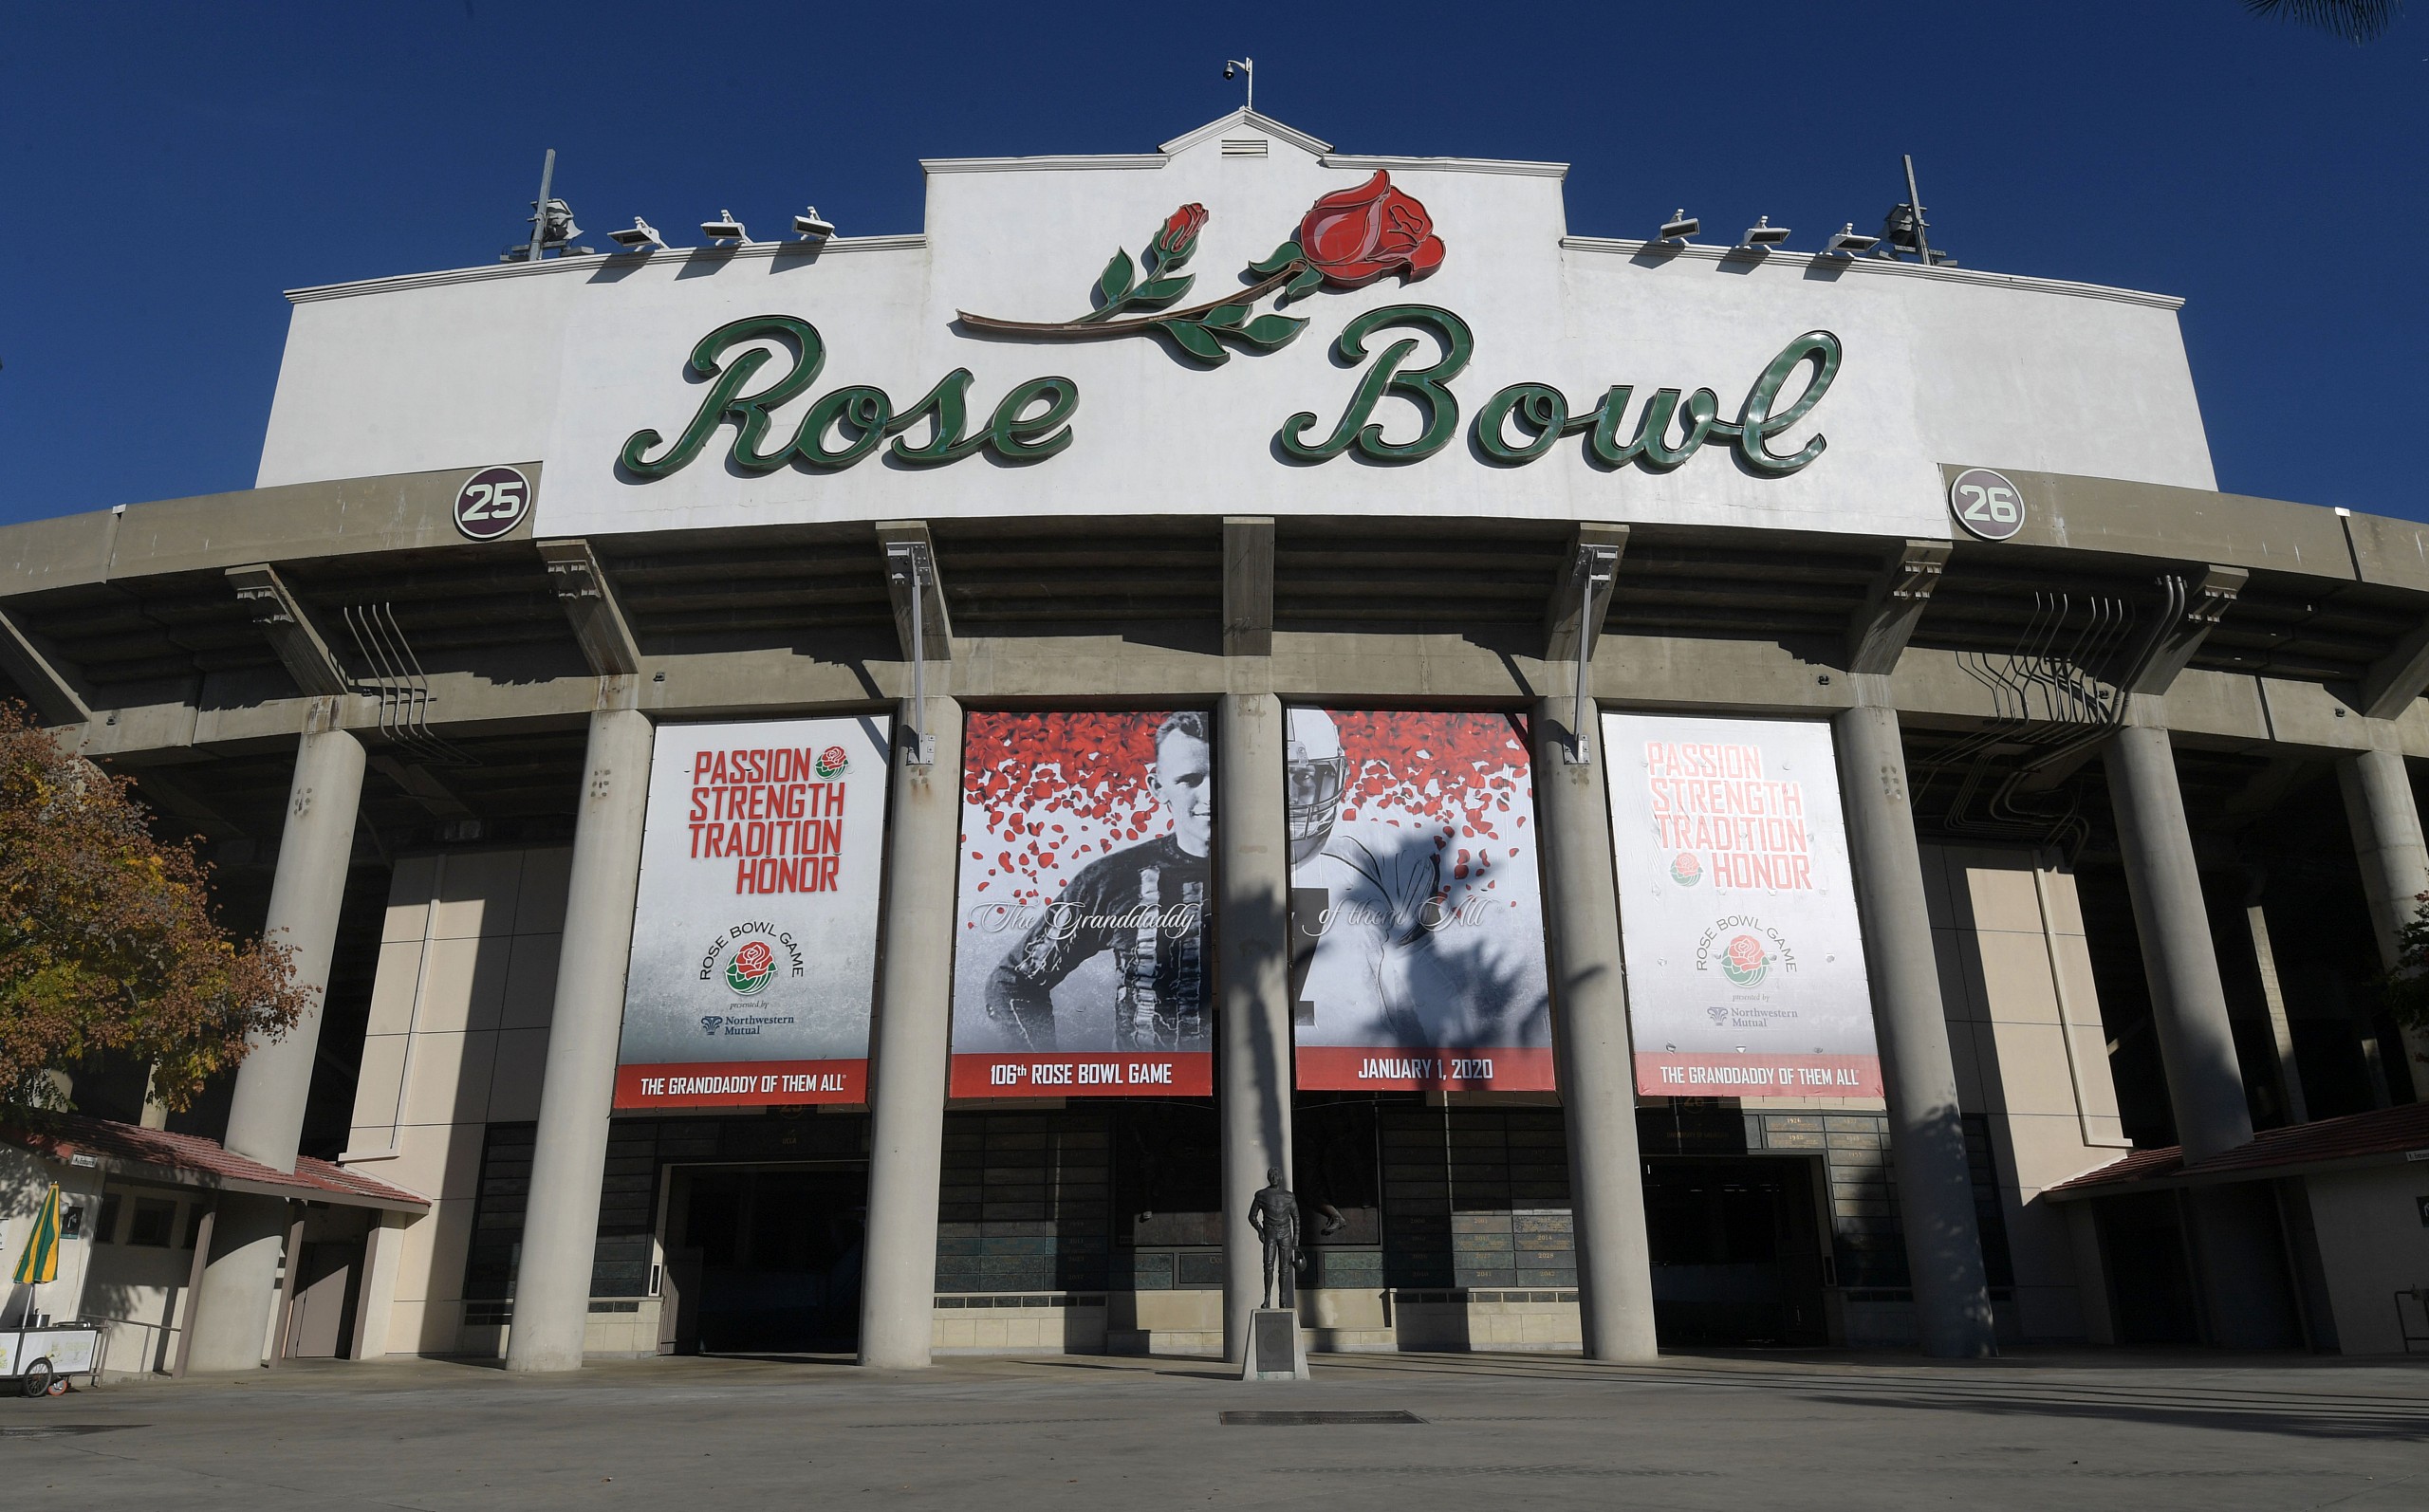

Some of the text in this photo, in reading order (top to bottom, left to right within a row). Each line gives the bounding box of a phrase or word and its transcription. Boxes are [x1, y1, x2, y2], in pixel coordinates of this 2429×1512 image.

[621, 304, 1843, 475] Rose Bowl
[461, 481, 523, 522] 25
[1959, 484, 2018, 523] 26
[693, 747, 812, 785] PASSION
[1646, 742, 1762, 780] PASSION
[689, 782, 845, 821] STRENGTH
[1650, 779, 1802, 817] STRENGTH
[688, 819, 843, 858] TRADITION
[1654, 813, 1808, 853] TRADITION
[736, 856, 840, 894] HONOR
[1713, 853, 1812, 891] HONOR
[968, 901, 1039, 932] The
[1044, 902, 1202, 940] Granddaddy
[1302, 897, 1348, 936] of
[1418, 896, 1496, 931] All
[699, 920, 805, 981] ROSE BOWL GAME
[1697, 914, 1797, 973] ROSE BOWL GAME
[730, 1000, 769, 1010] presented by
[1731, 1007, 1798, 1018] Northwestern
[1733, 993, 1771, 1003] presented by
[724, 1024, 761, 1036] Mutual
[726, 1014, 795, 1024] Northwestern
[1733, 1018, 1768, 1027] Mutual
[640, 1078, 666, 1096] THE
[668, 1076, 758, 1095] GRANDDADDY
[761, 1076, 779, 1093] OF
[782, 1075, 818, 1092] THEM
[991, 1063, 1173, 1086] 106th ROSE BOWL GAME
[1359, 1059, 1493, 1080] JANUARY 1, 2020
[1660, 1066, 1685, 1083] THE
[1688, 1066, 1774, 1085] GRANDDADDY
[1778, 1068, 1794, 1084] OF
[1797, 1068, 1833, 1085] THEM
